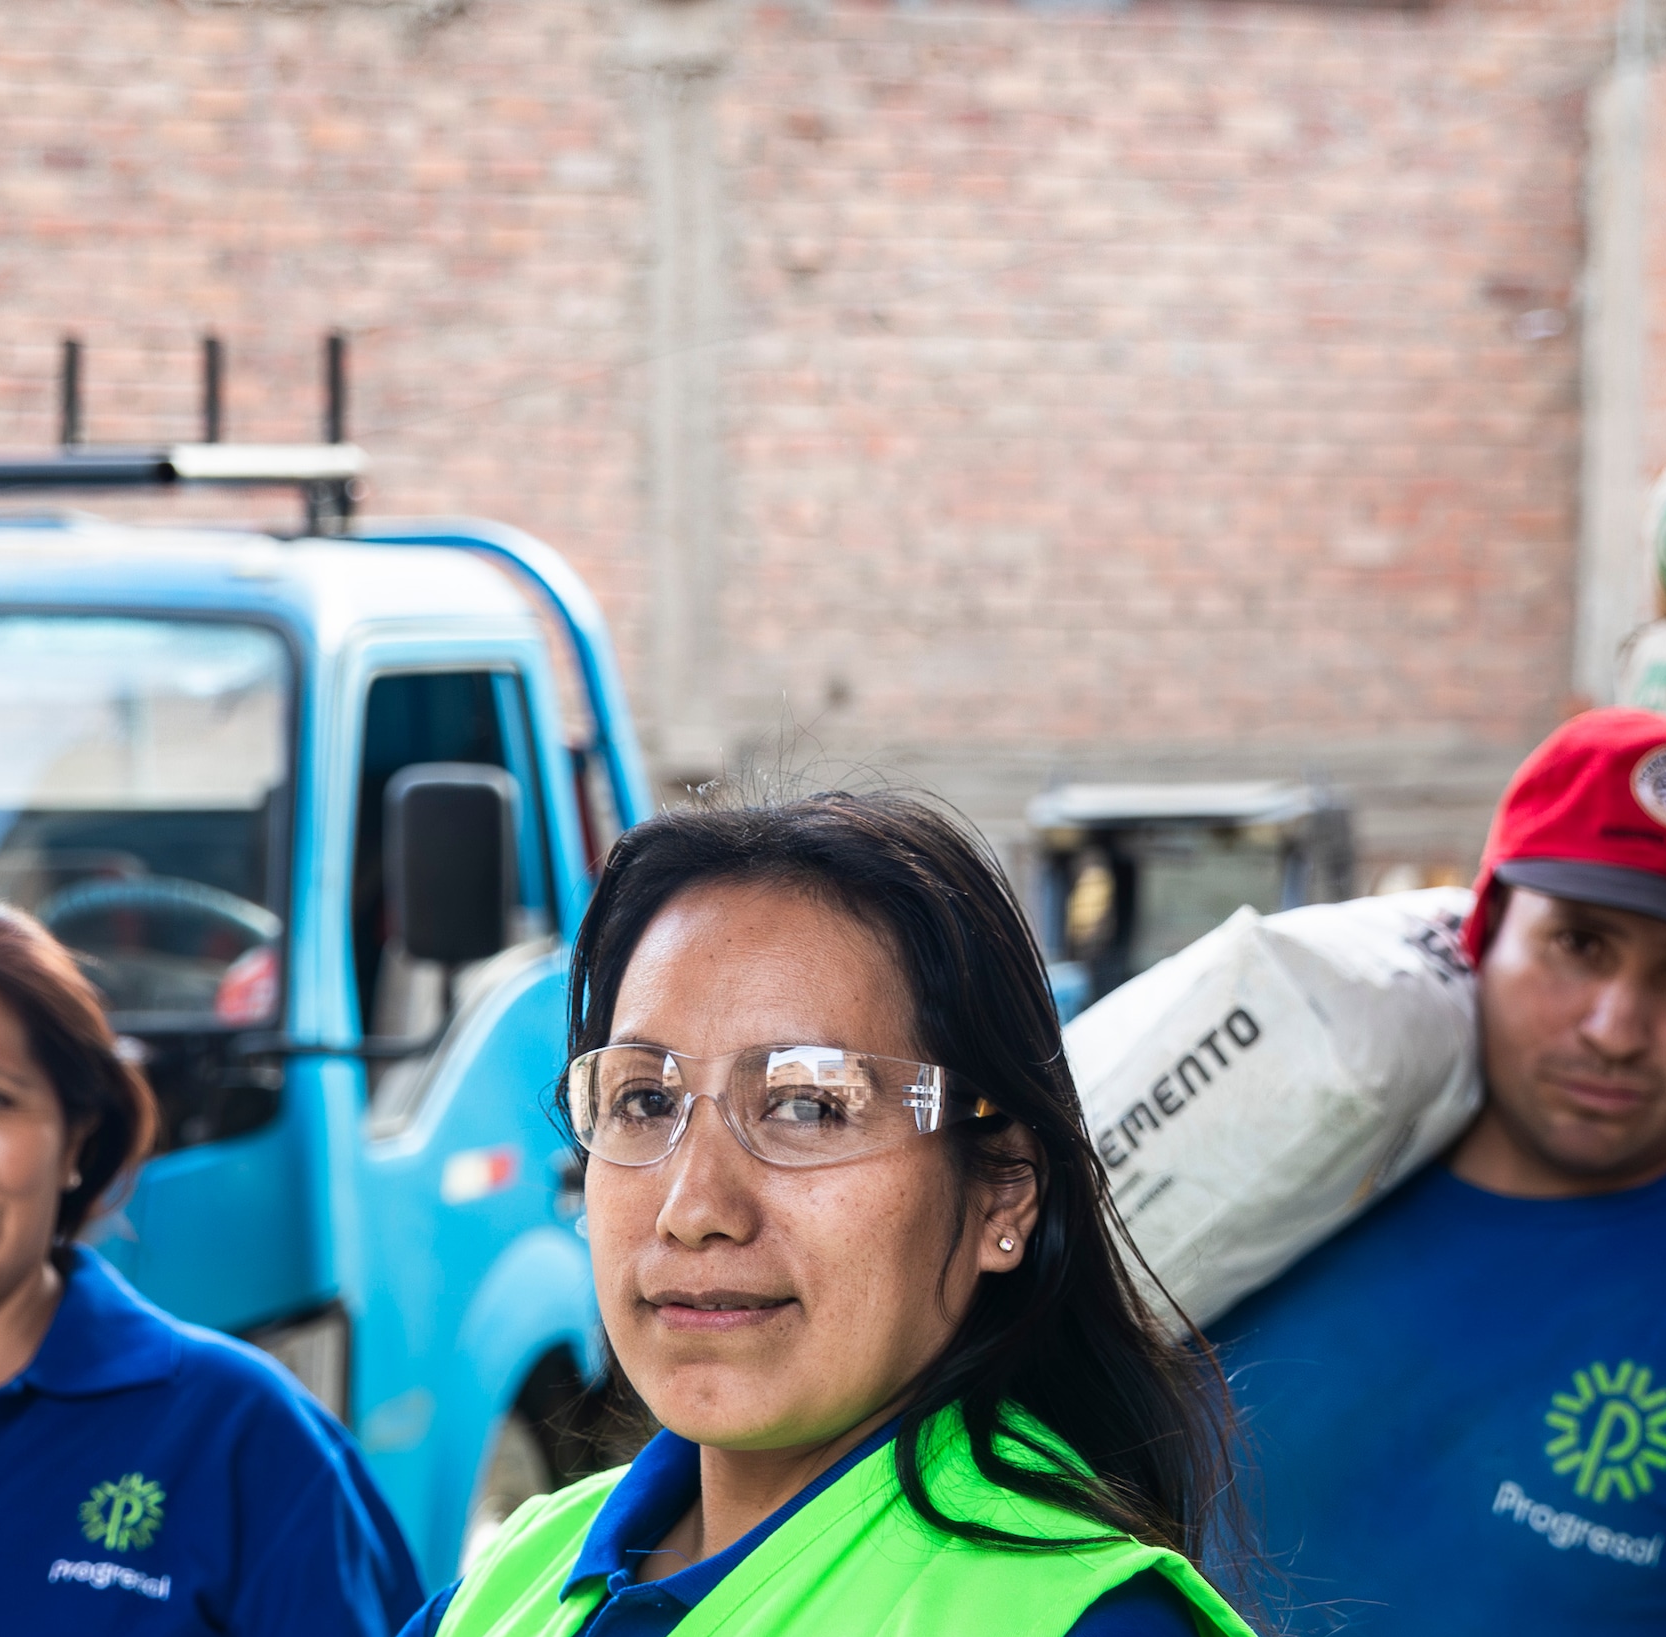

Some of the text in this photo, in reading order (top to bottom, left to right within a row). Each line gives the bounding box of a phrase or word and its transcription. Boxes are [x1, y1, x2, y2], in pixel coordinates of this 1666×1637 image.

[1097, 1003, 1261, 1169] EMENTO
[1491, 1480, 1665, 1568] Progresol
[47, 1558, 171, 1600] Progresol
